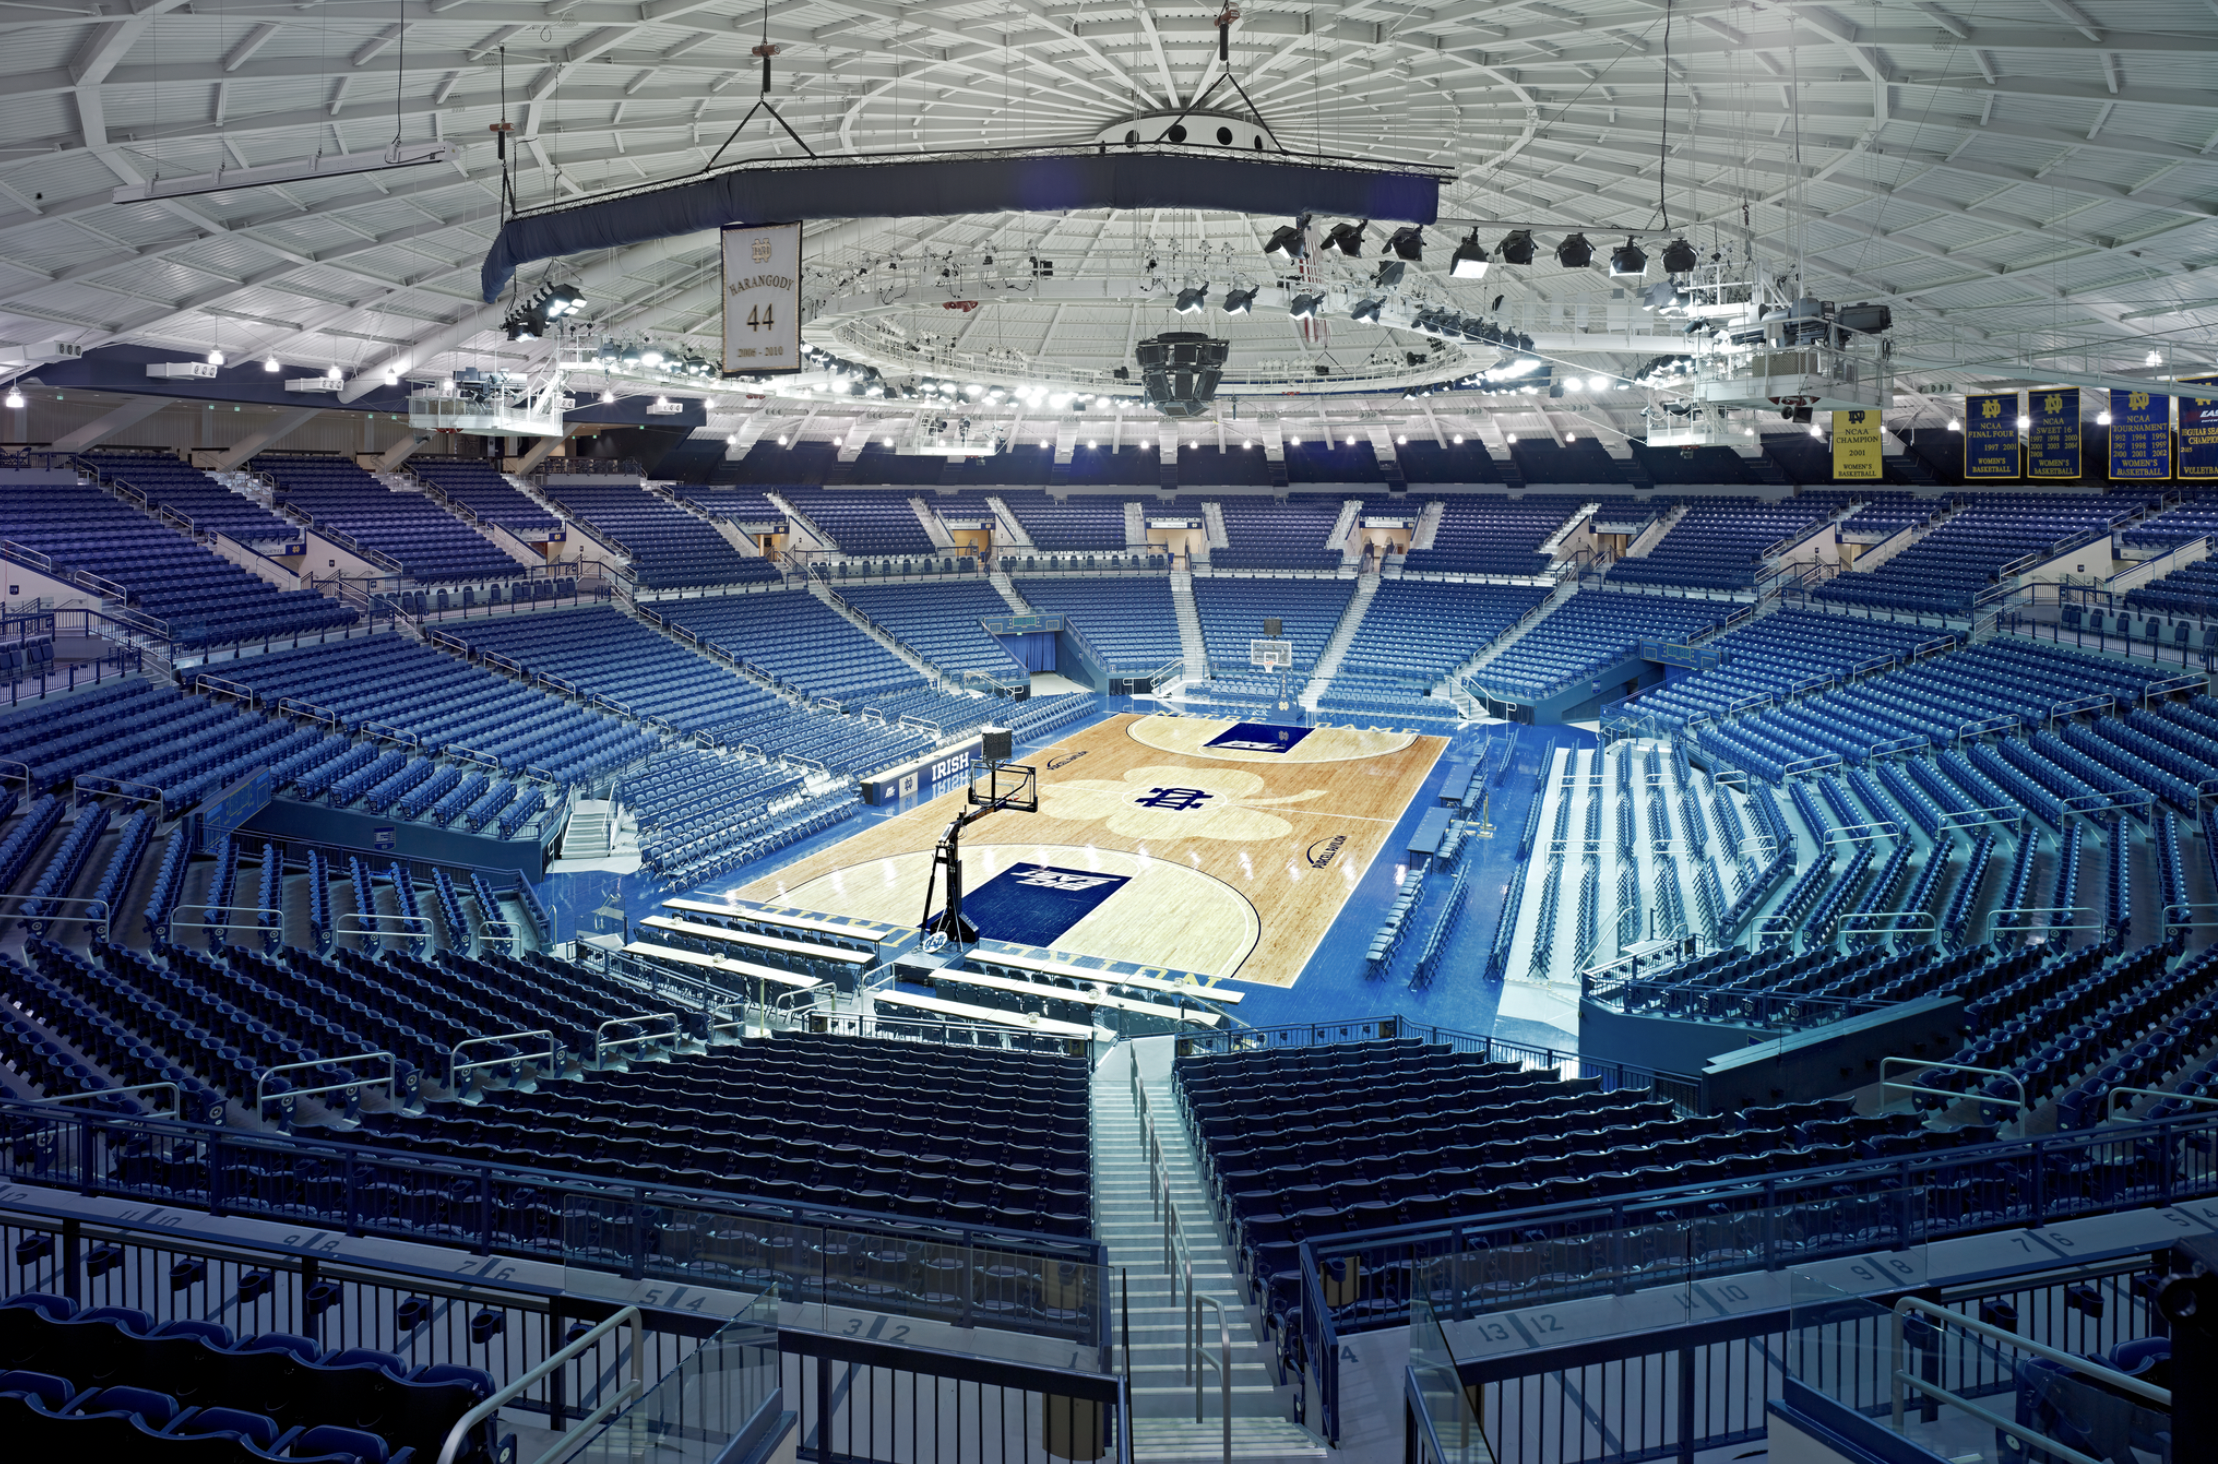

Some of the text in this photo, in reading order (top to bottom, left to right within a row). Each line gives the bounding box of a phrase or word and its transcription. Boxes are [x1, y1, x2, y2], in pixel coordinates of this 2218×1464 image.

[729, 274, 794, 296] HARANGODY
[746, 302, 774, 332] 44
[765, 346, 784, 356] 2010
[2112, 423, 2168, 432] TOURNAMENT
[2181, 428, 2206, 436] REGULAR
[1154, 710, 1420, 735] NOTRE DAME
[932, 752, 969, 782] IRISH
[2162, 1214, 2191, 1227] 5
[319, 1240, 339, 1252] 8
[2011, 1238, 2031, 1253] 7
[2048, 1232, 2074, 1246] 6
[453, 1260, 477, 1274] 7
[498, 1267, 516, 1280] 6
[1850, 1266, 1875, 1281] 9
[1889, 1259, 1914, 1274] 8
[640, 1289, 662, 1305] 5
[1673, 1292, 1700, 1310] 11
[1716, 1285, 1750, 1303] 10
[686, 1297, 706, 1311] 4
[842, 1318, 863, 1335] 3
[1530, 1314, 1564, 1333] 12
[890, 1325, 910, 1342] 2
[1477, 1323, 1510, 1342] 13
[1069, 1352, 1079, 1369] 1
